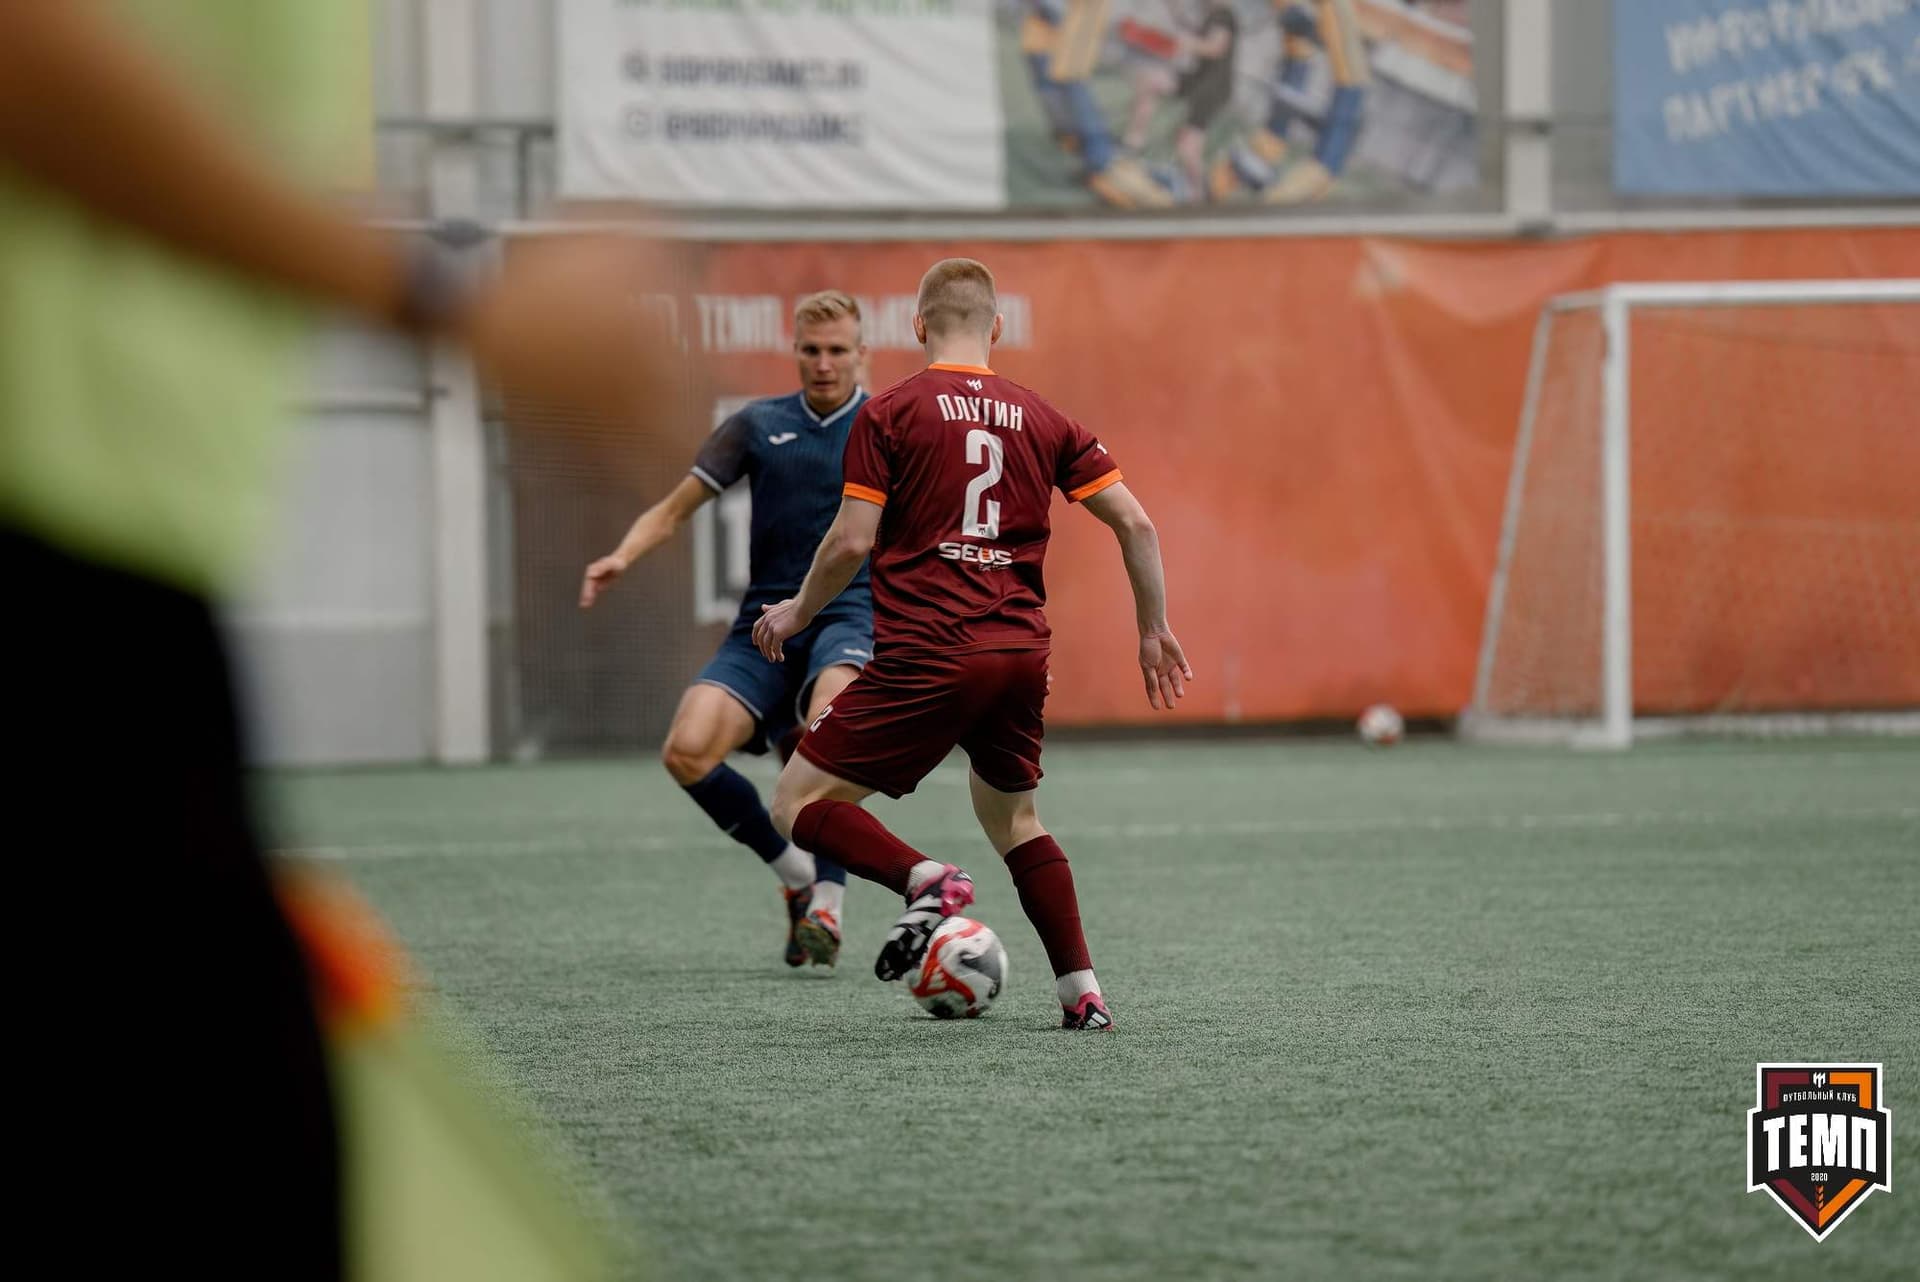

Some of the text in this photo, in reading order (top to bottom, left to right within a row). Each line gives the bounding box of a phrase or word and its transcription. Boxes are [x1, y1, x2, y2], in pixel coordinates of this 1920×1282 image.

[936, 393, 1024, 432] ПЛУГИН
[961, 428, 1004, 540] 2
[937, 541, 1014, 566] SEUS
